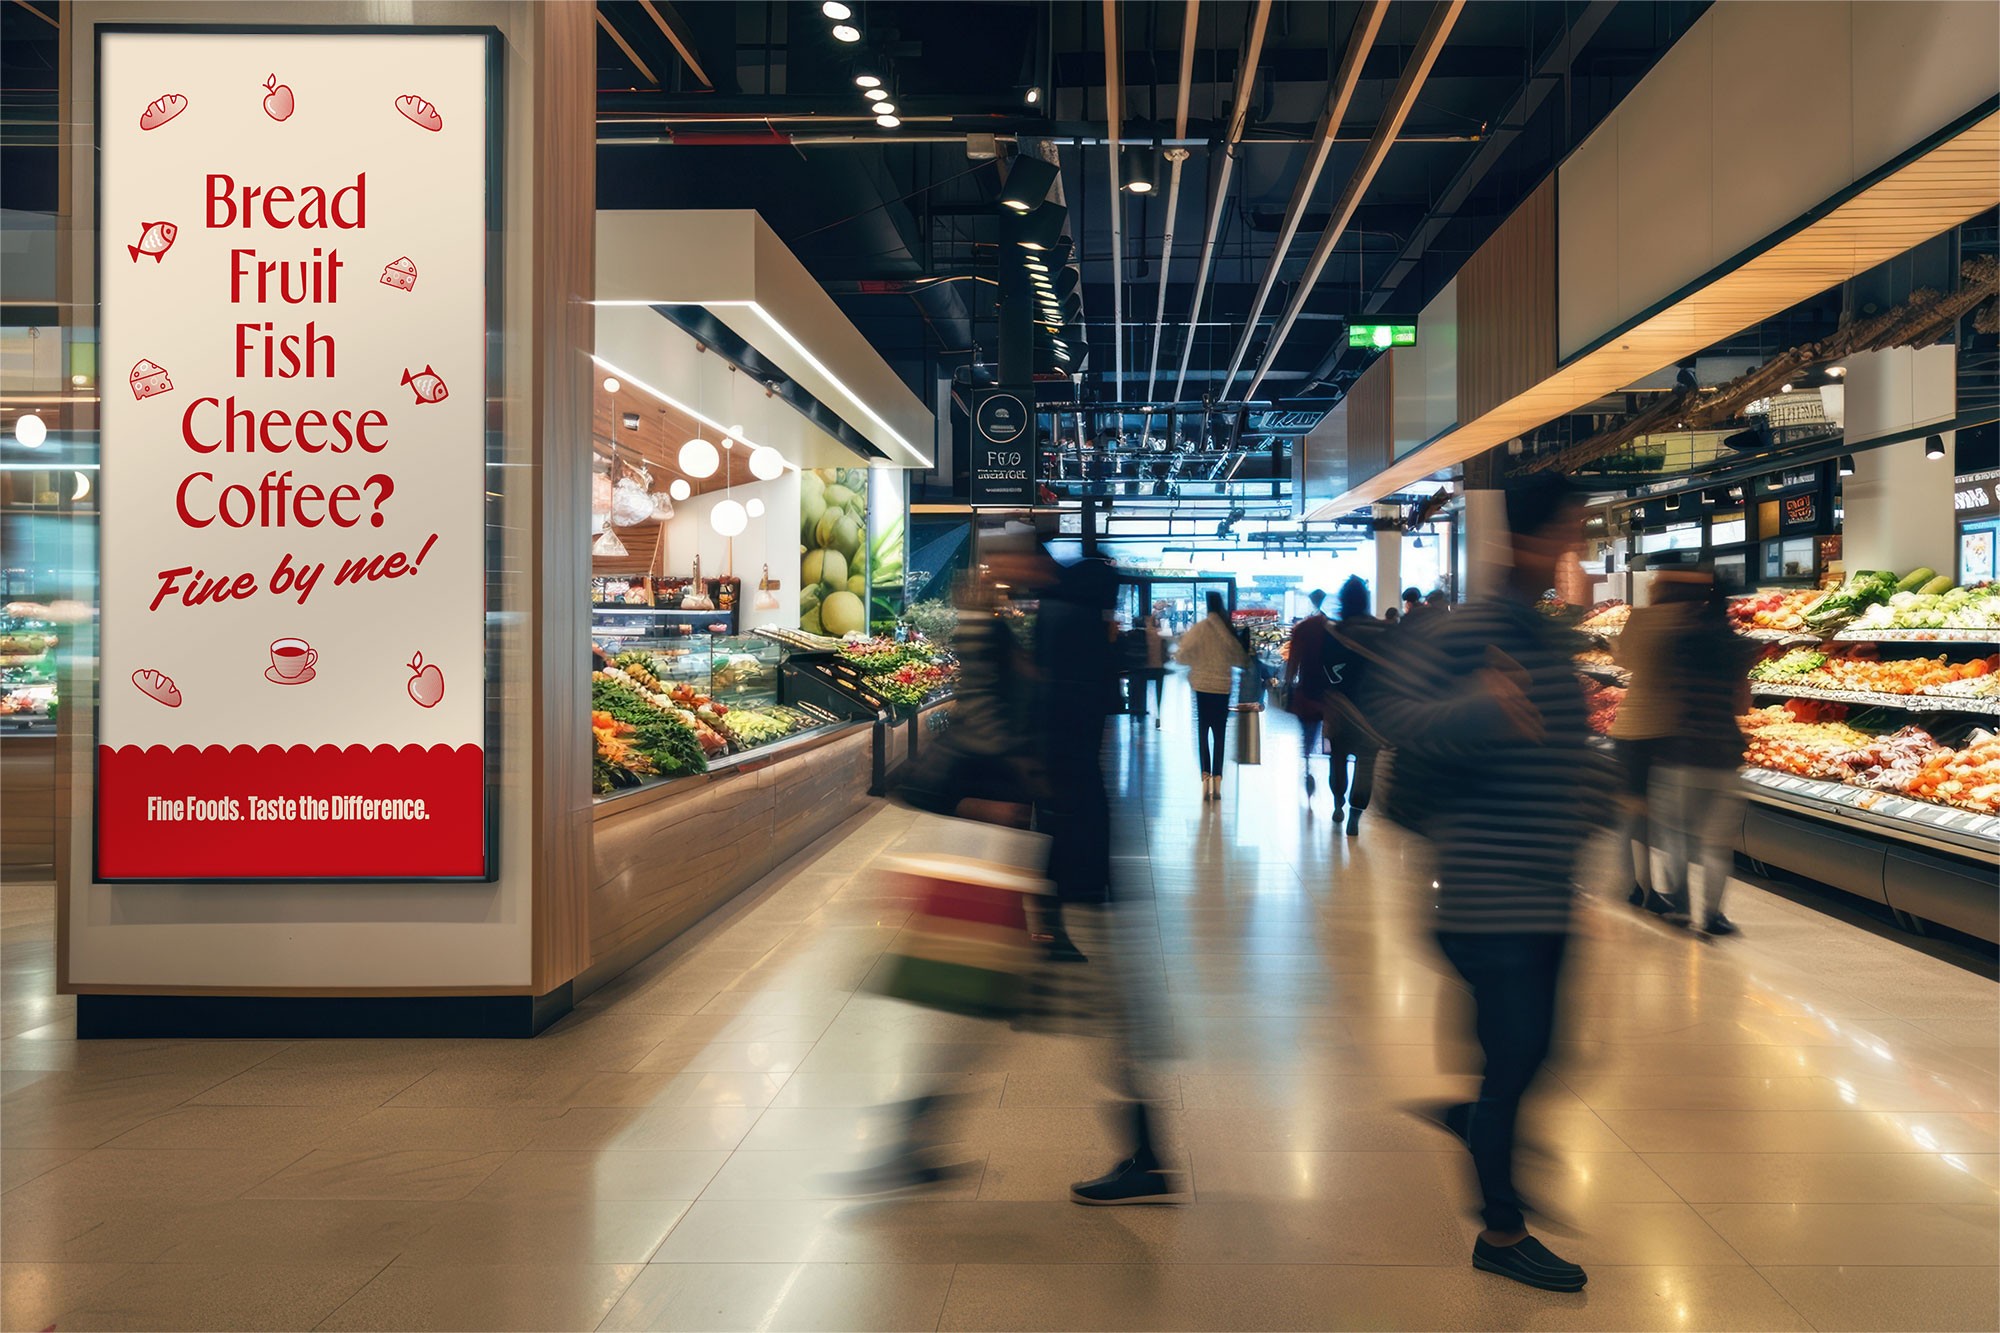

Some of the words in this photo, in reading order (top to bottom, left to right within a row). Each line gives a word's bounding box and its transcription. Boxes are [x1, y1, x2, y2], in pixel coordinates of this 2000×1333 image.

[205, 171, 366, 230] Bread
[230, 247, 344, 304] Fruit
[235, 321, 336, 379] Fish
[181, 395, 389, 455] Cheese
[175, 470, 395, 529] Coffee?
[149, 565, 259, 612] Fine
[269, 553, 325, 605] by
[333, 533, 439, 587] me!
[147, 796, 185, 821] Fine
[186, 795, 245, 821] Foods.
[247, 795, 297, 821] Taste
[298, 795, 329, 821] the
[331, 795, 430, 821] Difference.
